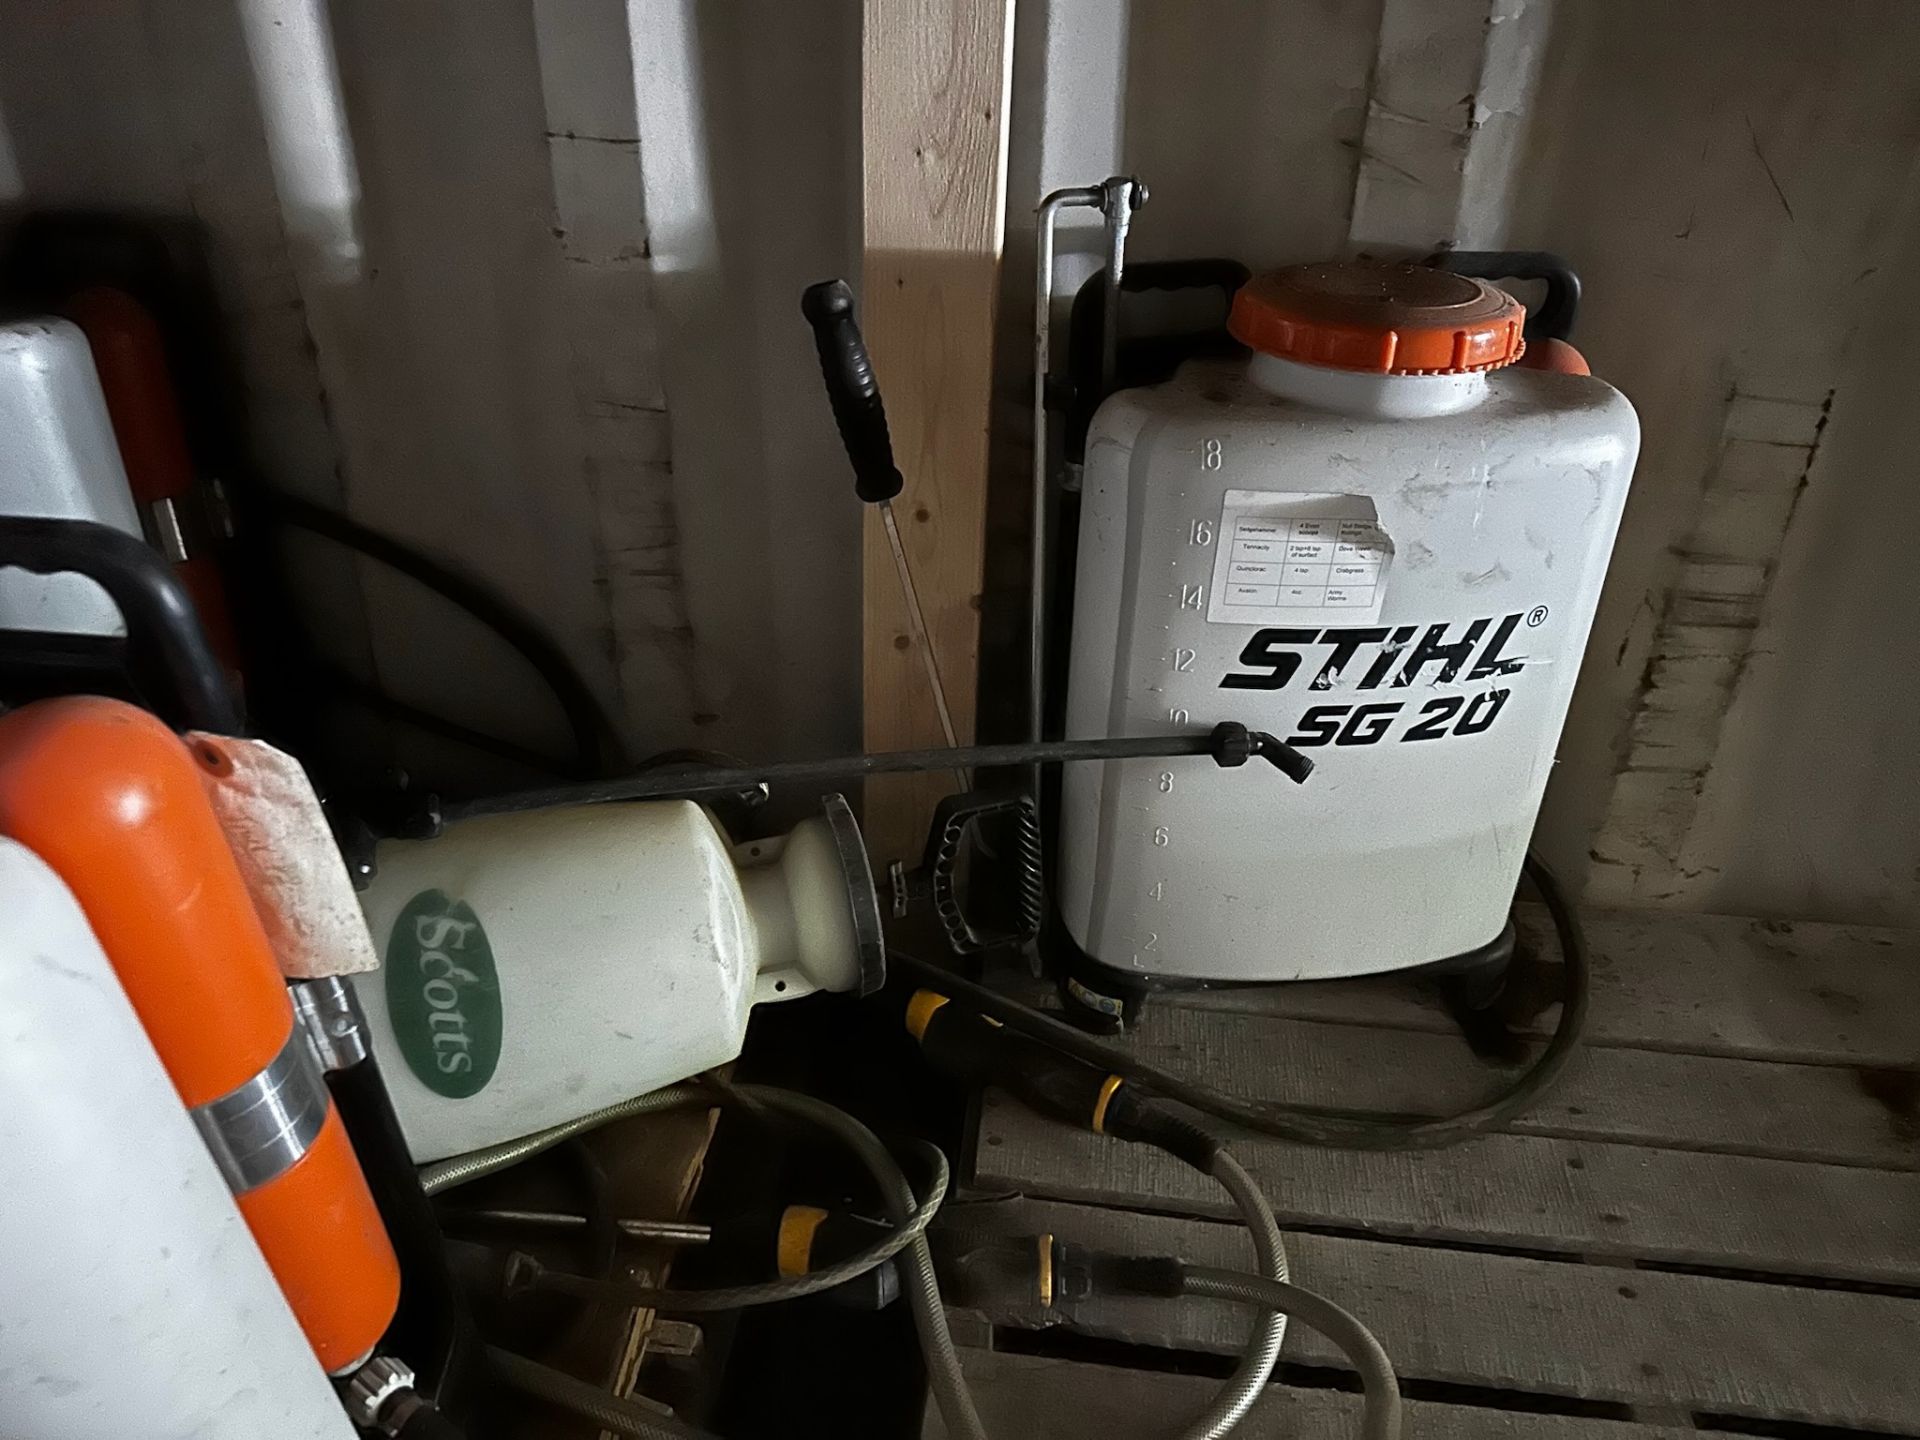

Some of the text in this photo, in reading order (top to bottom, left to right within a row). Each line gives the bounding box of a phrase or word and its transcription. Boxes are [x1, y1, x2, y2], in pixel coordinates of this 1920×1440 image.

[1201, 438, 1222, 471] 18
[1190, 518, 1213, 547] 16
[1181, 584, 1203, 611] 14
[1174, 648, 1196, 673] 12
[1218, 613, 1528, 691] STIHL
[1286, 689, 1511, 746] SG 20
[1159, 771, 1175, 794] 8
[1154, 826, 1169, 848] 6
[1149, 881, 1162, 901] 4
[1144, 932, 1158, 951] 2
[416, 914, 479, 1074] Scotts
